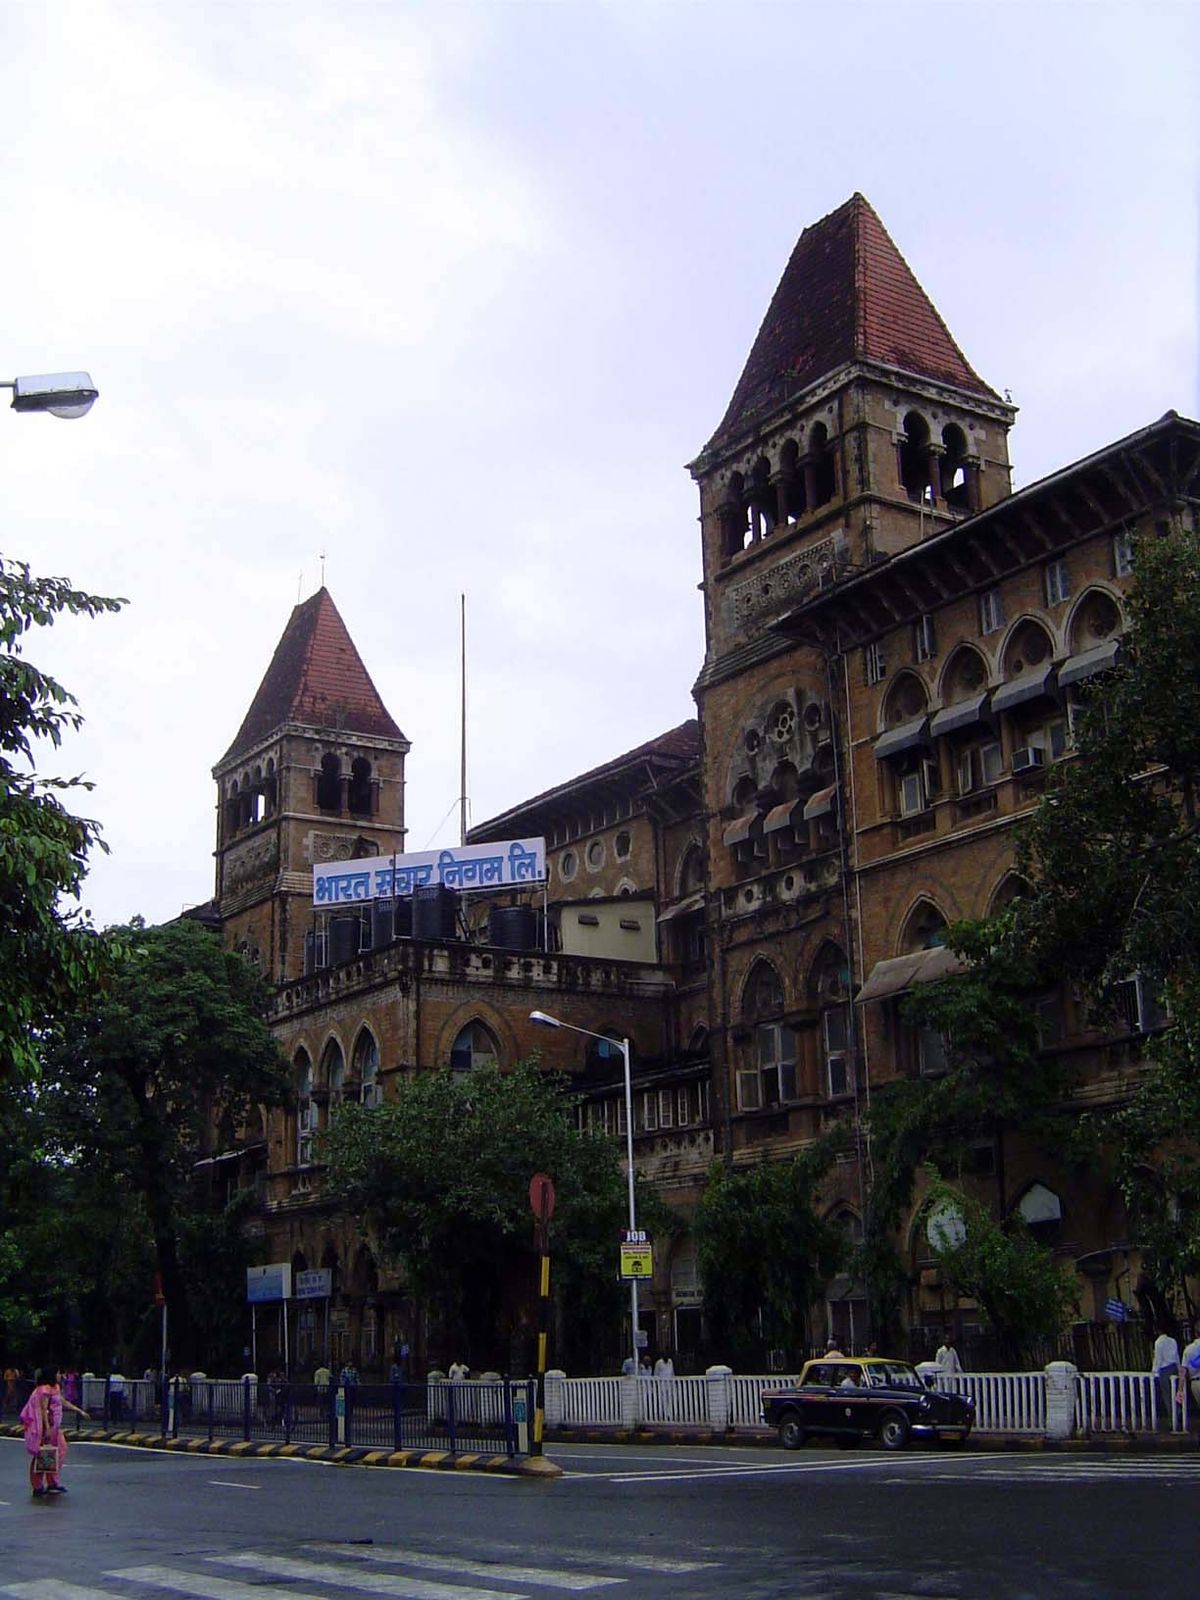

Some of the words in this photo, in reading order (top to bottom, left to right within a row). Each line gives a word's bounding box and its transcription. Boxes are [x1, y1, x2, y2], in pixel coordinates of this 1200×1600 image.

[315, 874, 371, 901] भारत
[438, 851, 504, 886] निगम
[508, 842, 543, 881] लि.
